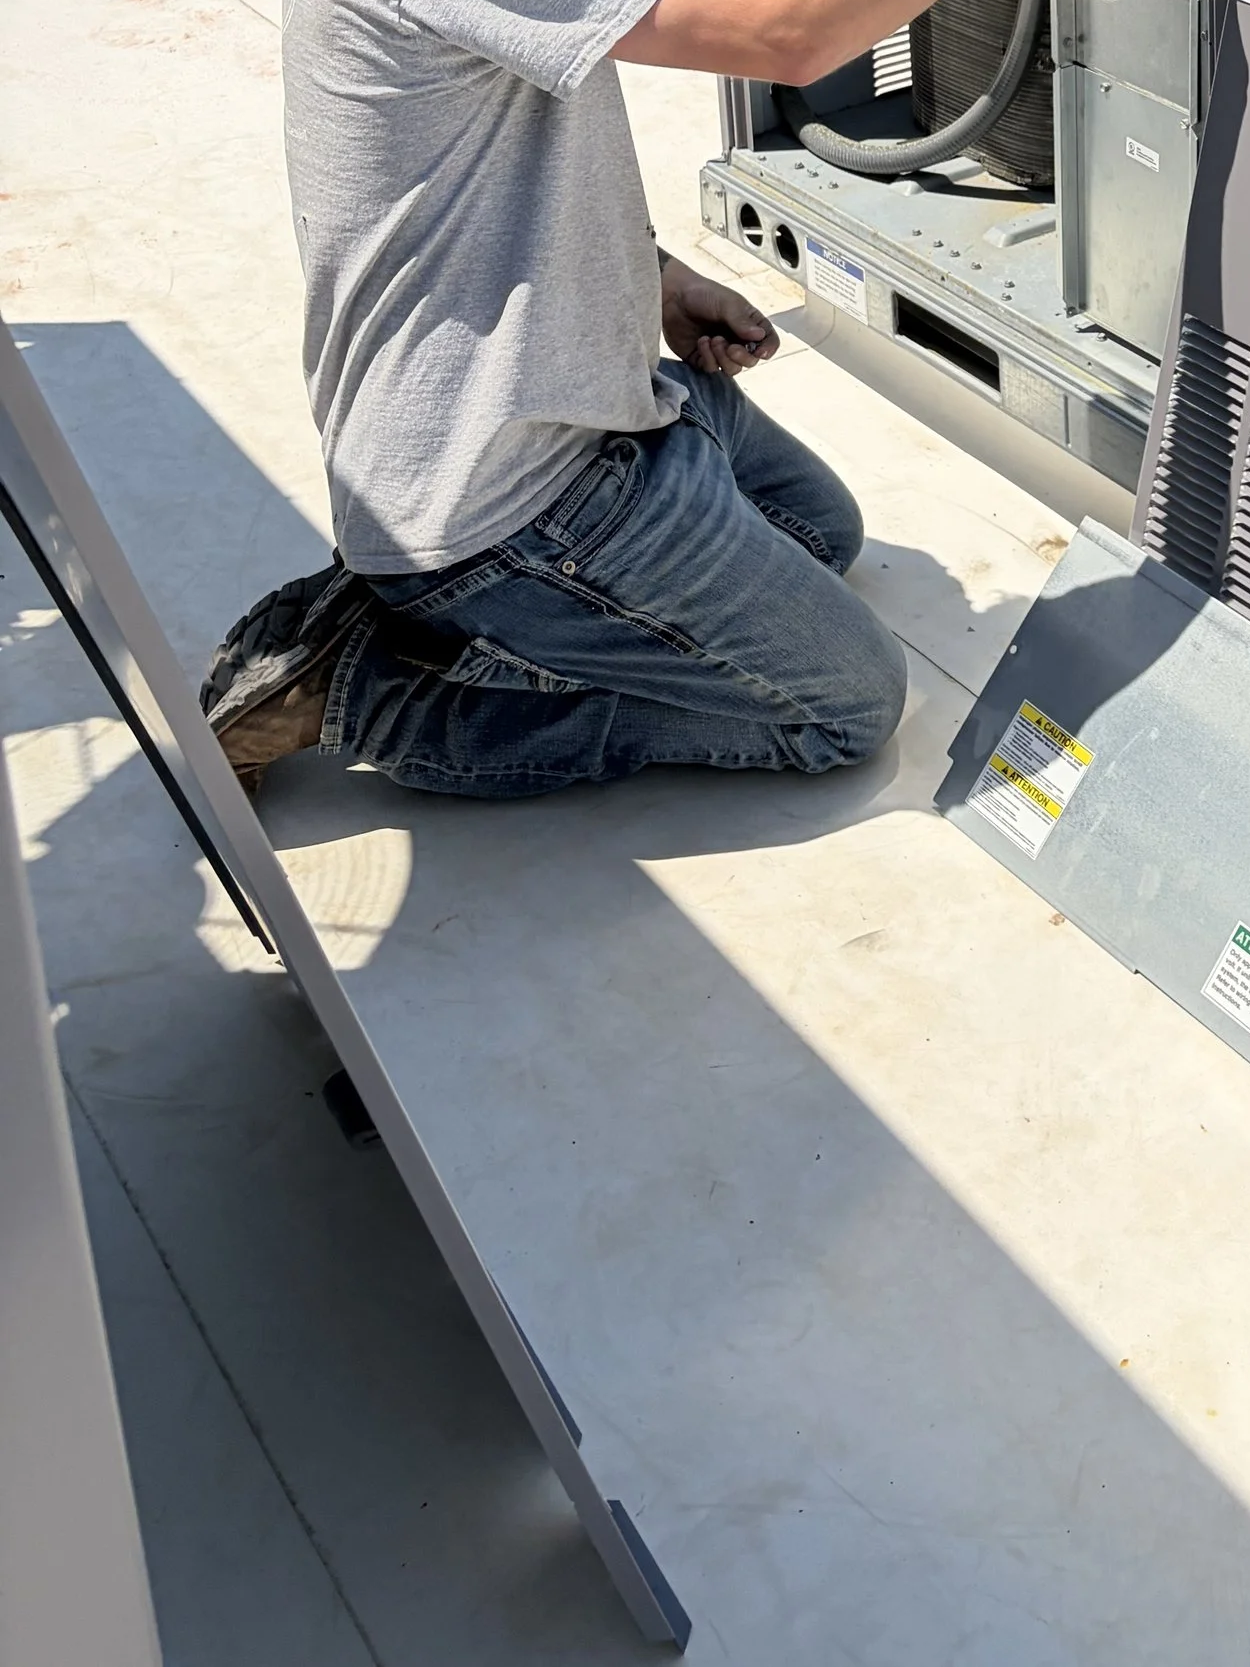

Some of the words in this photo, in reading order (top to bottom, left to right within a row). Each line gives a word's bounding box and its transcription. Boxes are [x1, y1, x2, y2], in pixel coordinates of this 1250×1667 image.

[823, 248, 846, 269] NOTICE
[1042, 721, 1077, 752] CAUTION
[1008, 769, 1050, 808] ATTENTION
[1228, 948, 1242, 962] Only
[1215, 974, 1230, 988] Refer
[1229, 985, 1236, 993] to
[1234, 989, 1250, 1007] wiring
[1239, 980, 1249, 991] the
